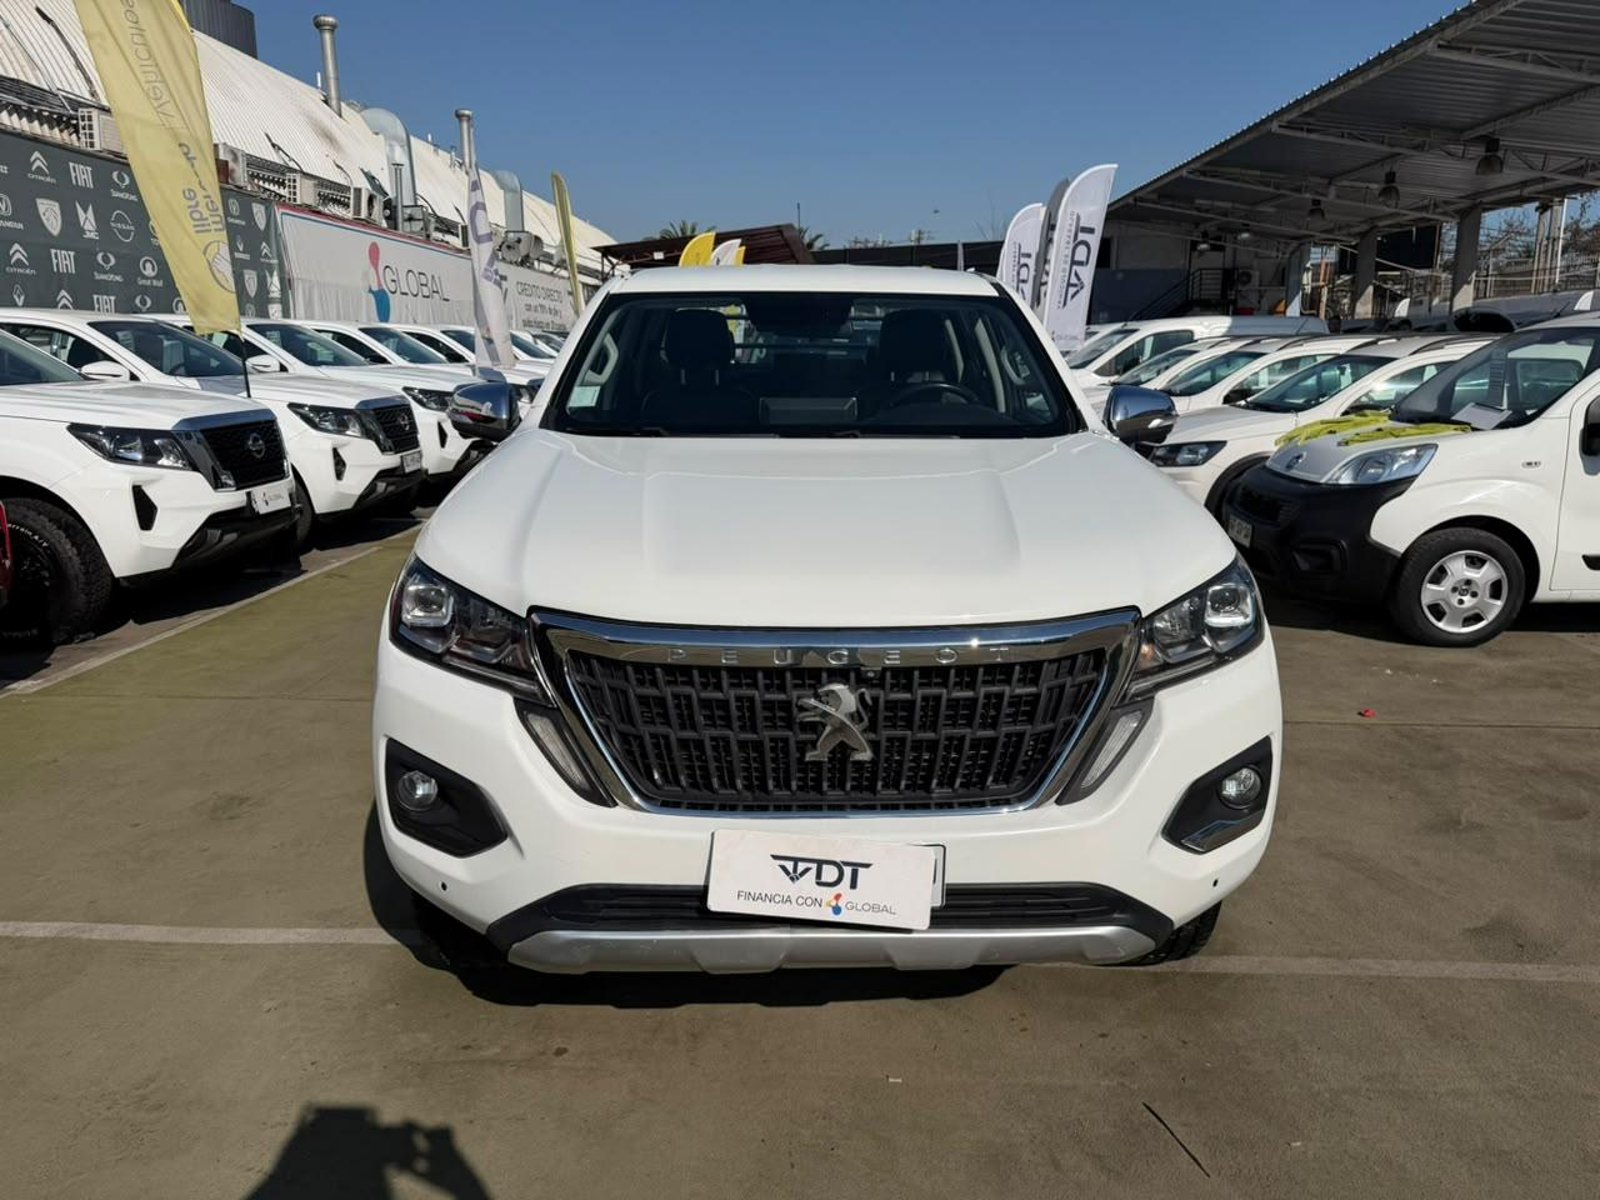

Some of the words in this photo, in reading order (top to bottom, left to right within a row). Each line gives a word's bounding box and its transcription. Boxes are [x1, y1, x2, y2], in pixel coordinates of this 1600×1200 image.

[68, 161, 94, 189] FIAT
[50, 248, 76, 275] FIAT
[382, 264, 451, 302] GLOBAL
[92, 294, 117, 313] FIAT
[668, 647, 1009, 665] PEUGEOT
[770, 854, 873, 890] VDT
[736, 890, 793, 906] FINANCIA
[795, 894, 823, 908] CON
[845, 901, 896, 916] GLOBAL
